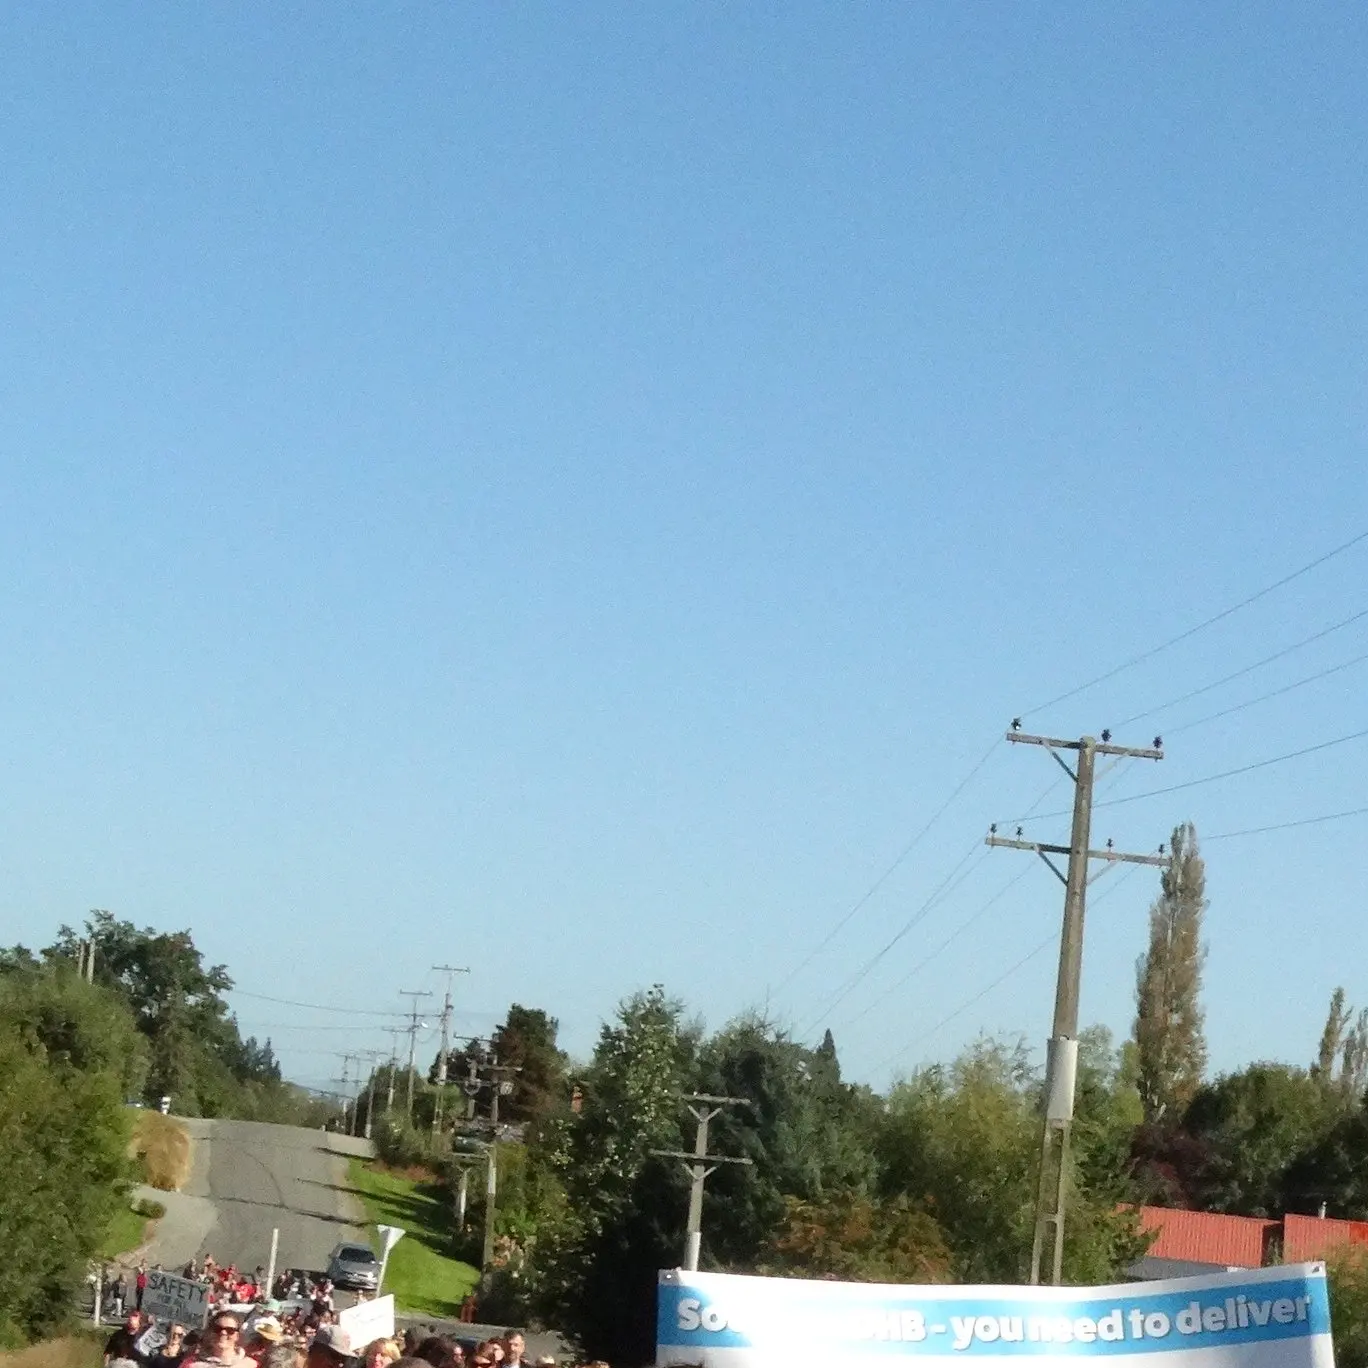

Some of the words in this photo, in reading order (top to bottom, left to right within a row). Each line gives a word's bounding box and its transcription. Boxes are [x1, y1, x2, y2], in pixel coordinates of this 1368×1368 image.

[950, 1313, 1024, 1351] you
[1028, 1309, 1125, 1343] need
[1131, 1308, 1171, 1339] to
[1176, 1294, 1311, 1336] deliver
